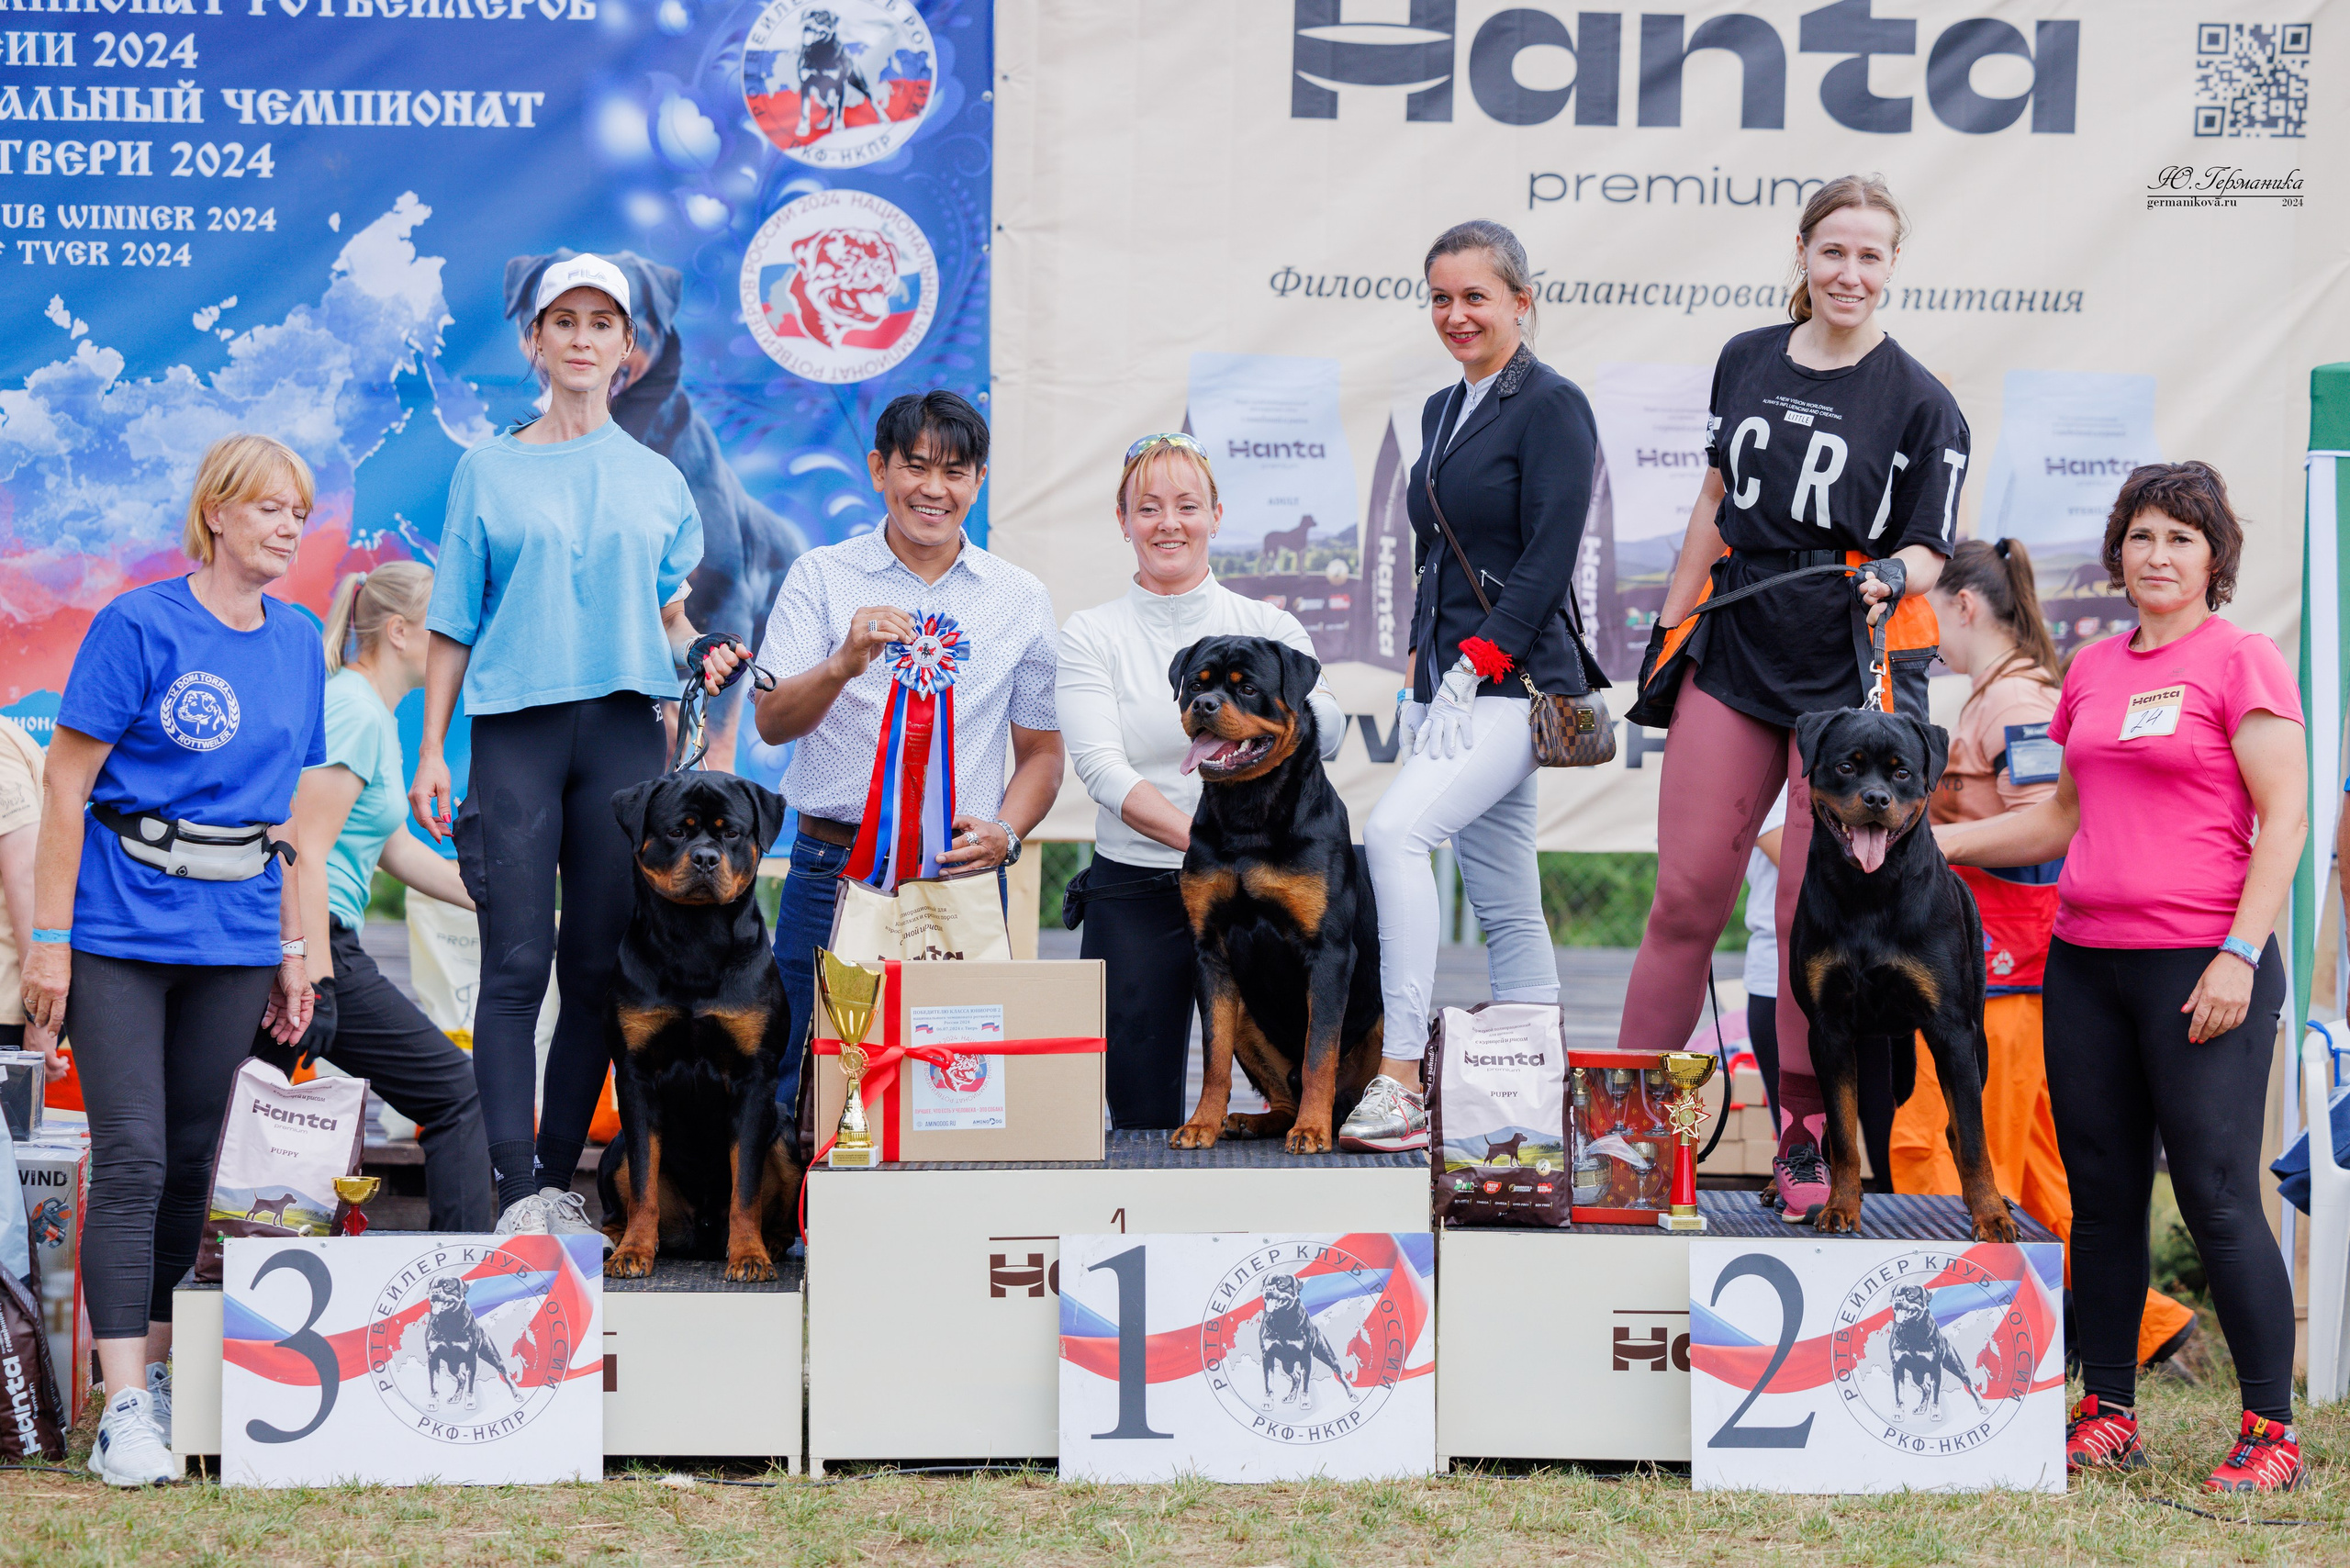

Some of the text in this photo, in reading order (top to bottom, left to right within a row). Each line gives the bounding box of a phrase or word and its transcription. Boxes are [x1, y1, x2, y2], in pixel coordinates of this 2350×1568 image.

[0, 31, 198, 69] ИИ 2024
[1291, 0, 2081, 134] Hanta
[0, 79, 545, 127] АЛЬНЫЙ ЧЕМПИОНАТ
[0, 140, 275, 178] ТВЕРИ 2024
[57, 205, 196, 230] WINNER
[207, 207, 277, 231] 2024
[17, 241, 110, 266] TVER
[121, 242, 192, 267] 2024
[567, 268, 607, 282] FILA
[1900, 286, 2086, 314] питания
[1787, 412, 1809, 424] LITTLE
[1806, 402, 1834, 413] WORLDWIDE
[1228, 440, 1326, 459] Hanta
[1379, 535, 1398, 658] Hanta
[170, 688, 179, 698] IZ
[199, 674, 229, 693] TORRA
[2132, 690, 2180, 706] Hanta
[177, 730, 231, 748] ROTTWEILER
[252, 1098, 338, 1131] Hanta
[270, 1147, 299, 1158] PUPPY
[370, 1248, 567, 1392] РОТВЕЙЛЕР КЛУБ РОССИИ
[1203, 1244, 1403, 1391] РОТВЕЙЛЕР КЛУБ РОССИИ
[1834, 1255, 2031, 1402] РОТВЕЙЛЕР КЛУБ РОССИИ
[245, 1249, 341, 1444] 3
[1087, 1244, 1174, 1439] 1
[1707, 1253, 1816, 1449] 2
[2, 1355, 42, 1456] Hanta
[417, 1410, 525, 1441] РКФ-НКПР
[1251, 1410, 1362, 1441] РКФ-НКПР
[1882, 1423, 1991, 1453] РКФ-НКПР
